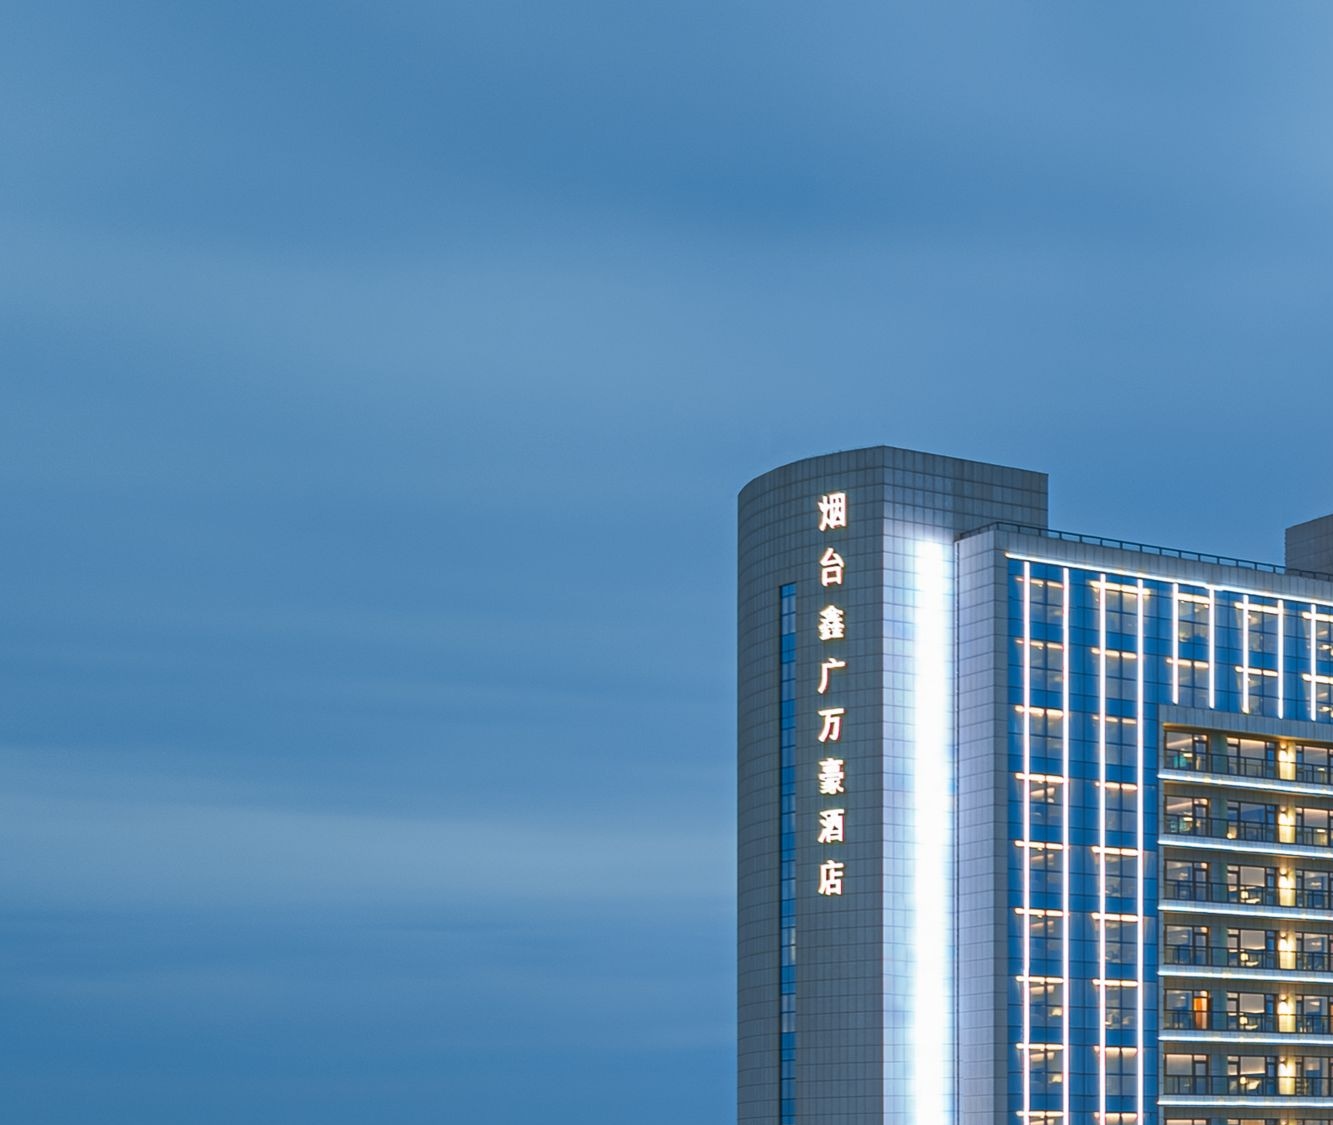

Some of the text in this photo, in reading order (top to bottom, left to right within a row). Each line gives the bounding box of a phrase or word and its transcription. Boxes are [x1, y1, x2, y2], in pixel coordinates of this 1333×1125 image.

[818, 492, 847, 896] 烟台鑫广万豪酒店
